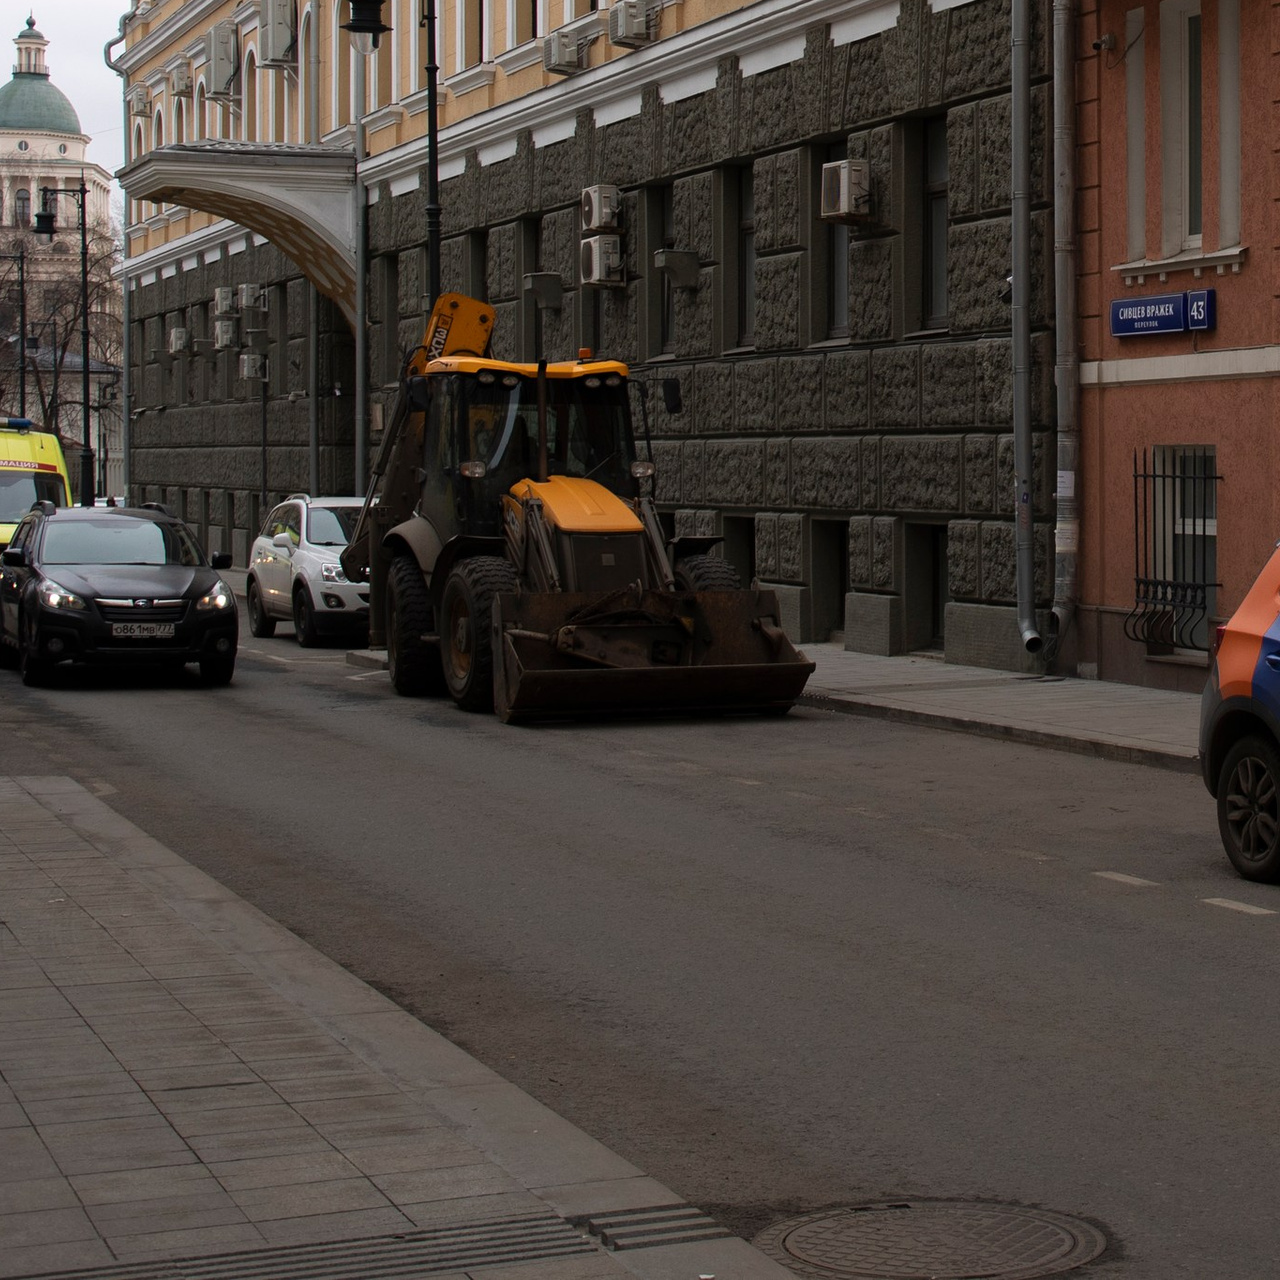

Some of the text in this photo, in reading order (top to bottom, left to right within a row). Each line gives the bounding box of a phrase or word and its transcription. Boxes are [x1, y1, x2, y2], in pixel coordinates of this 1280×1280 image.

[1119, 303, 1174, 320] СИВЦЕВ ВРАЖЕК
[1190, 301, 1204, 320] 43
